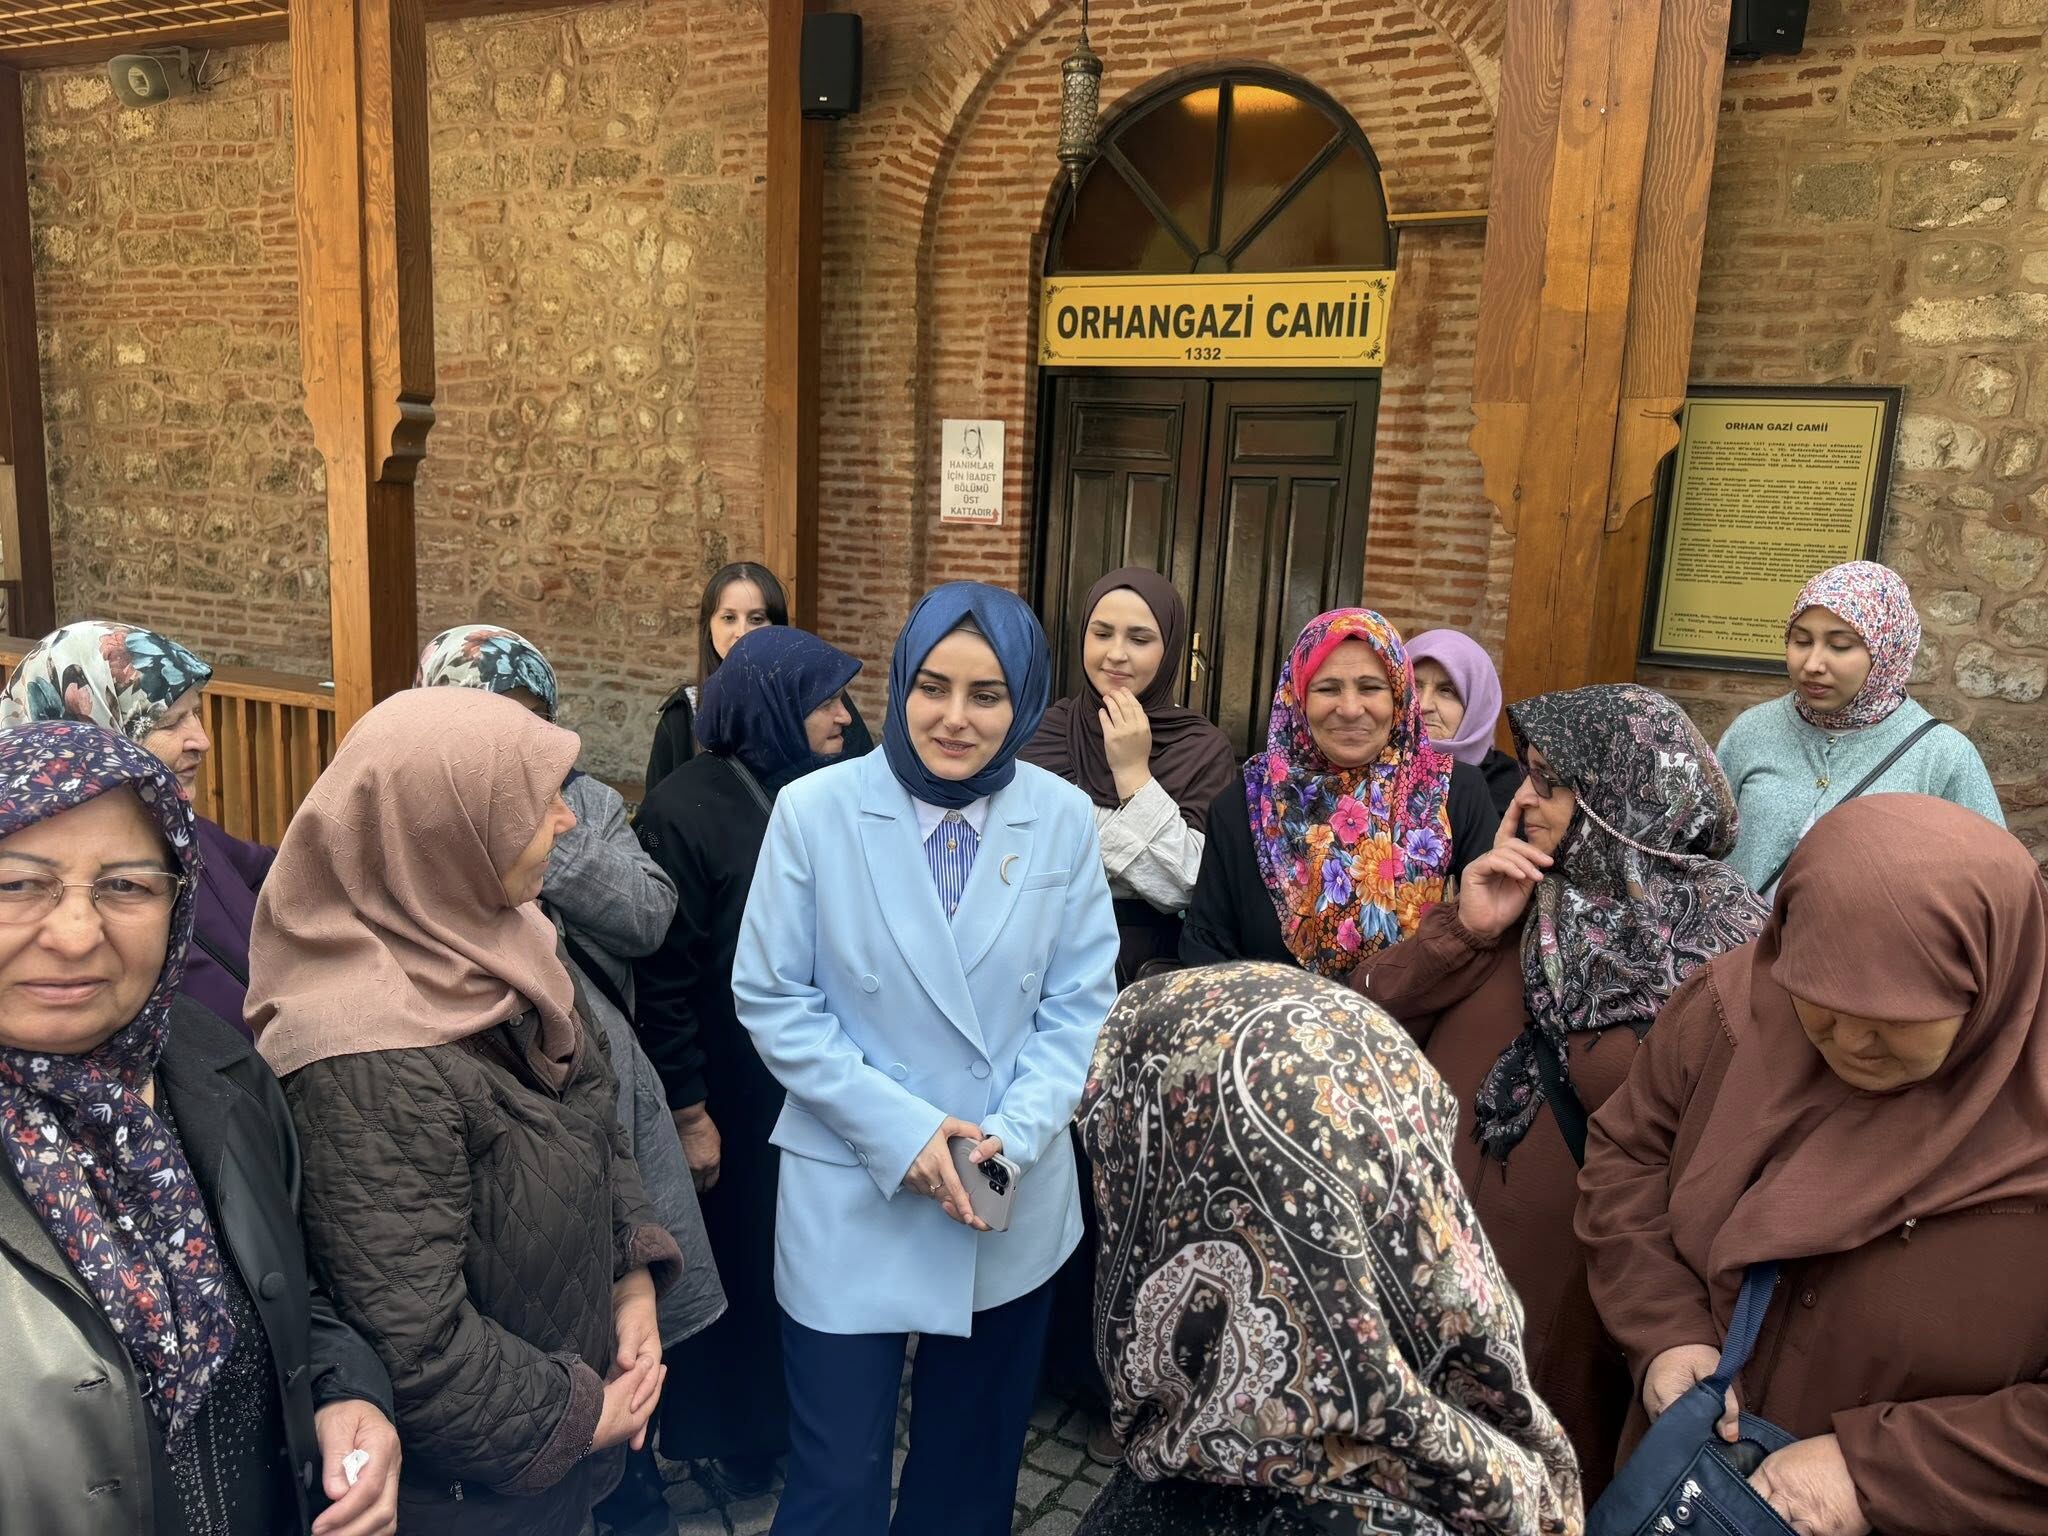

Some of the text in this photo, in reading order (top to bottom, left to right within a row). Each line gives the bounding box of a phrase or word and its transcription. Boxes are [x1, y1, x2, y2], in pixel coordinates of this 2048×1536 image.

[1057, 292, 1370, 339] ORHANGAZİ CAMİİ
[1184, 347, 1222, 361] 1332
[1725, 421, 1828, 432] ORHAN GAZİ CAMİİ
[949, 460, 995, 470] HANIMLAR
[947, 470, 997, 482] İÇİN İBADET
[954, 482, 989, 493] BÖLÜMÜ
[963, 494, 980, 504] ÜST
[950, 506, 992, 516] KATTADIR
